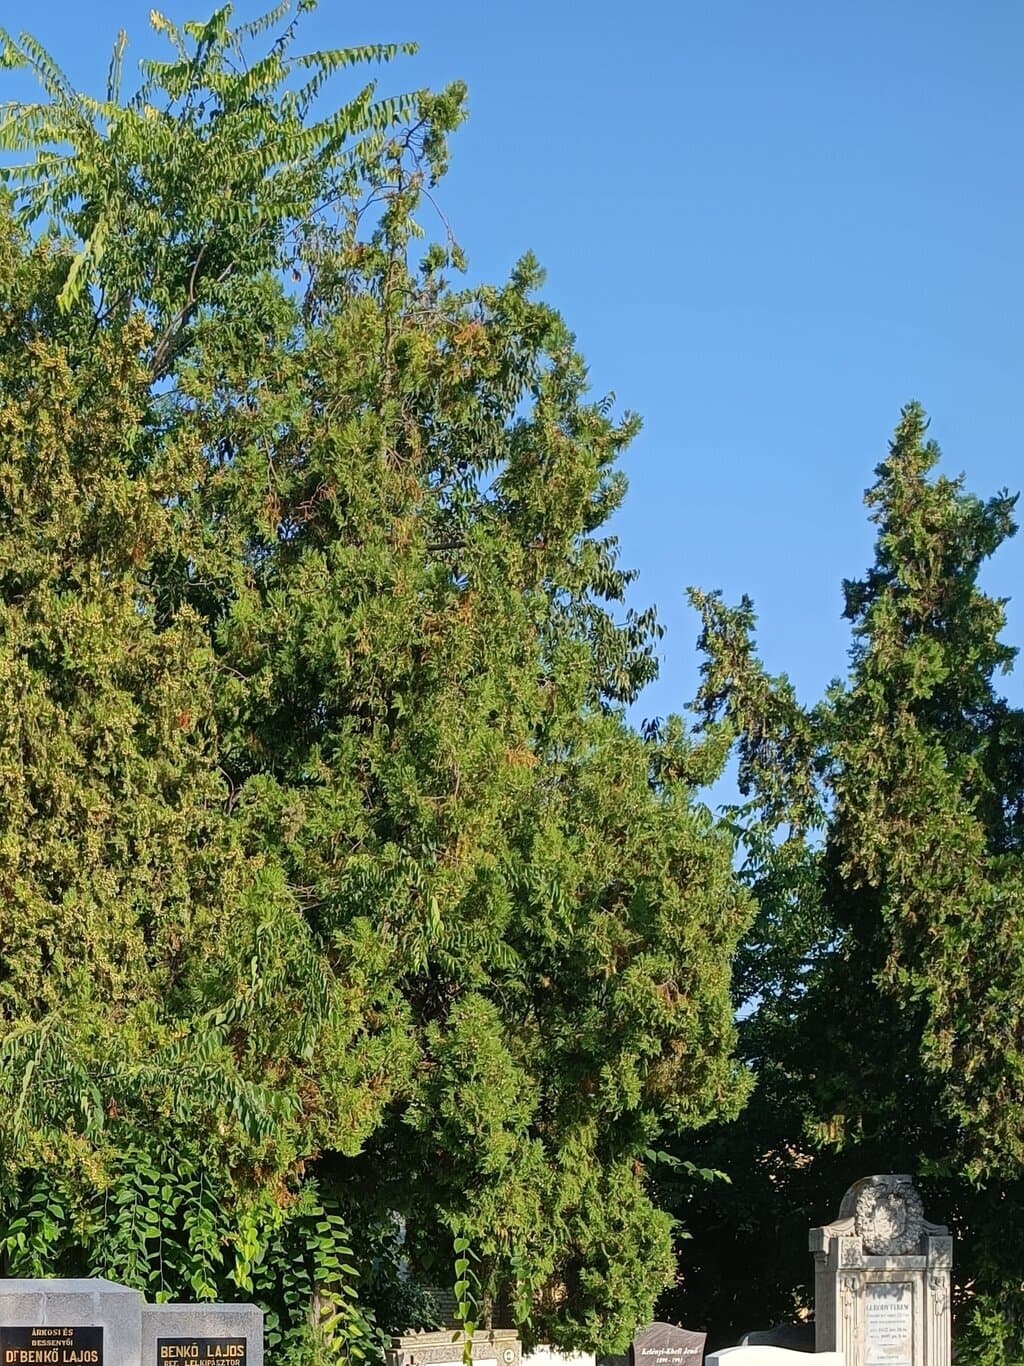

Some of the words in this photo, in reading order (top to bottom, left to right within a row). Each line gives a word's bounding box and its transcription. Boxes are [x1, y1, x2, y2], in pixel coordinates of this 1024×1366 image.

[20, 1347, 59, 1363] BENKŐ
[63, 1350, 98, 1363] LAJOS
[207, 1345, 245, 1357] LAJOS
